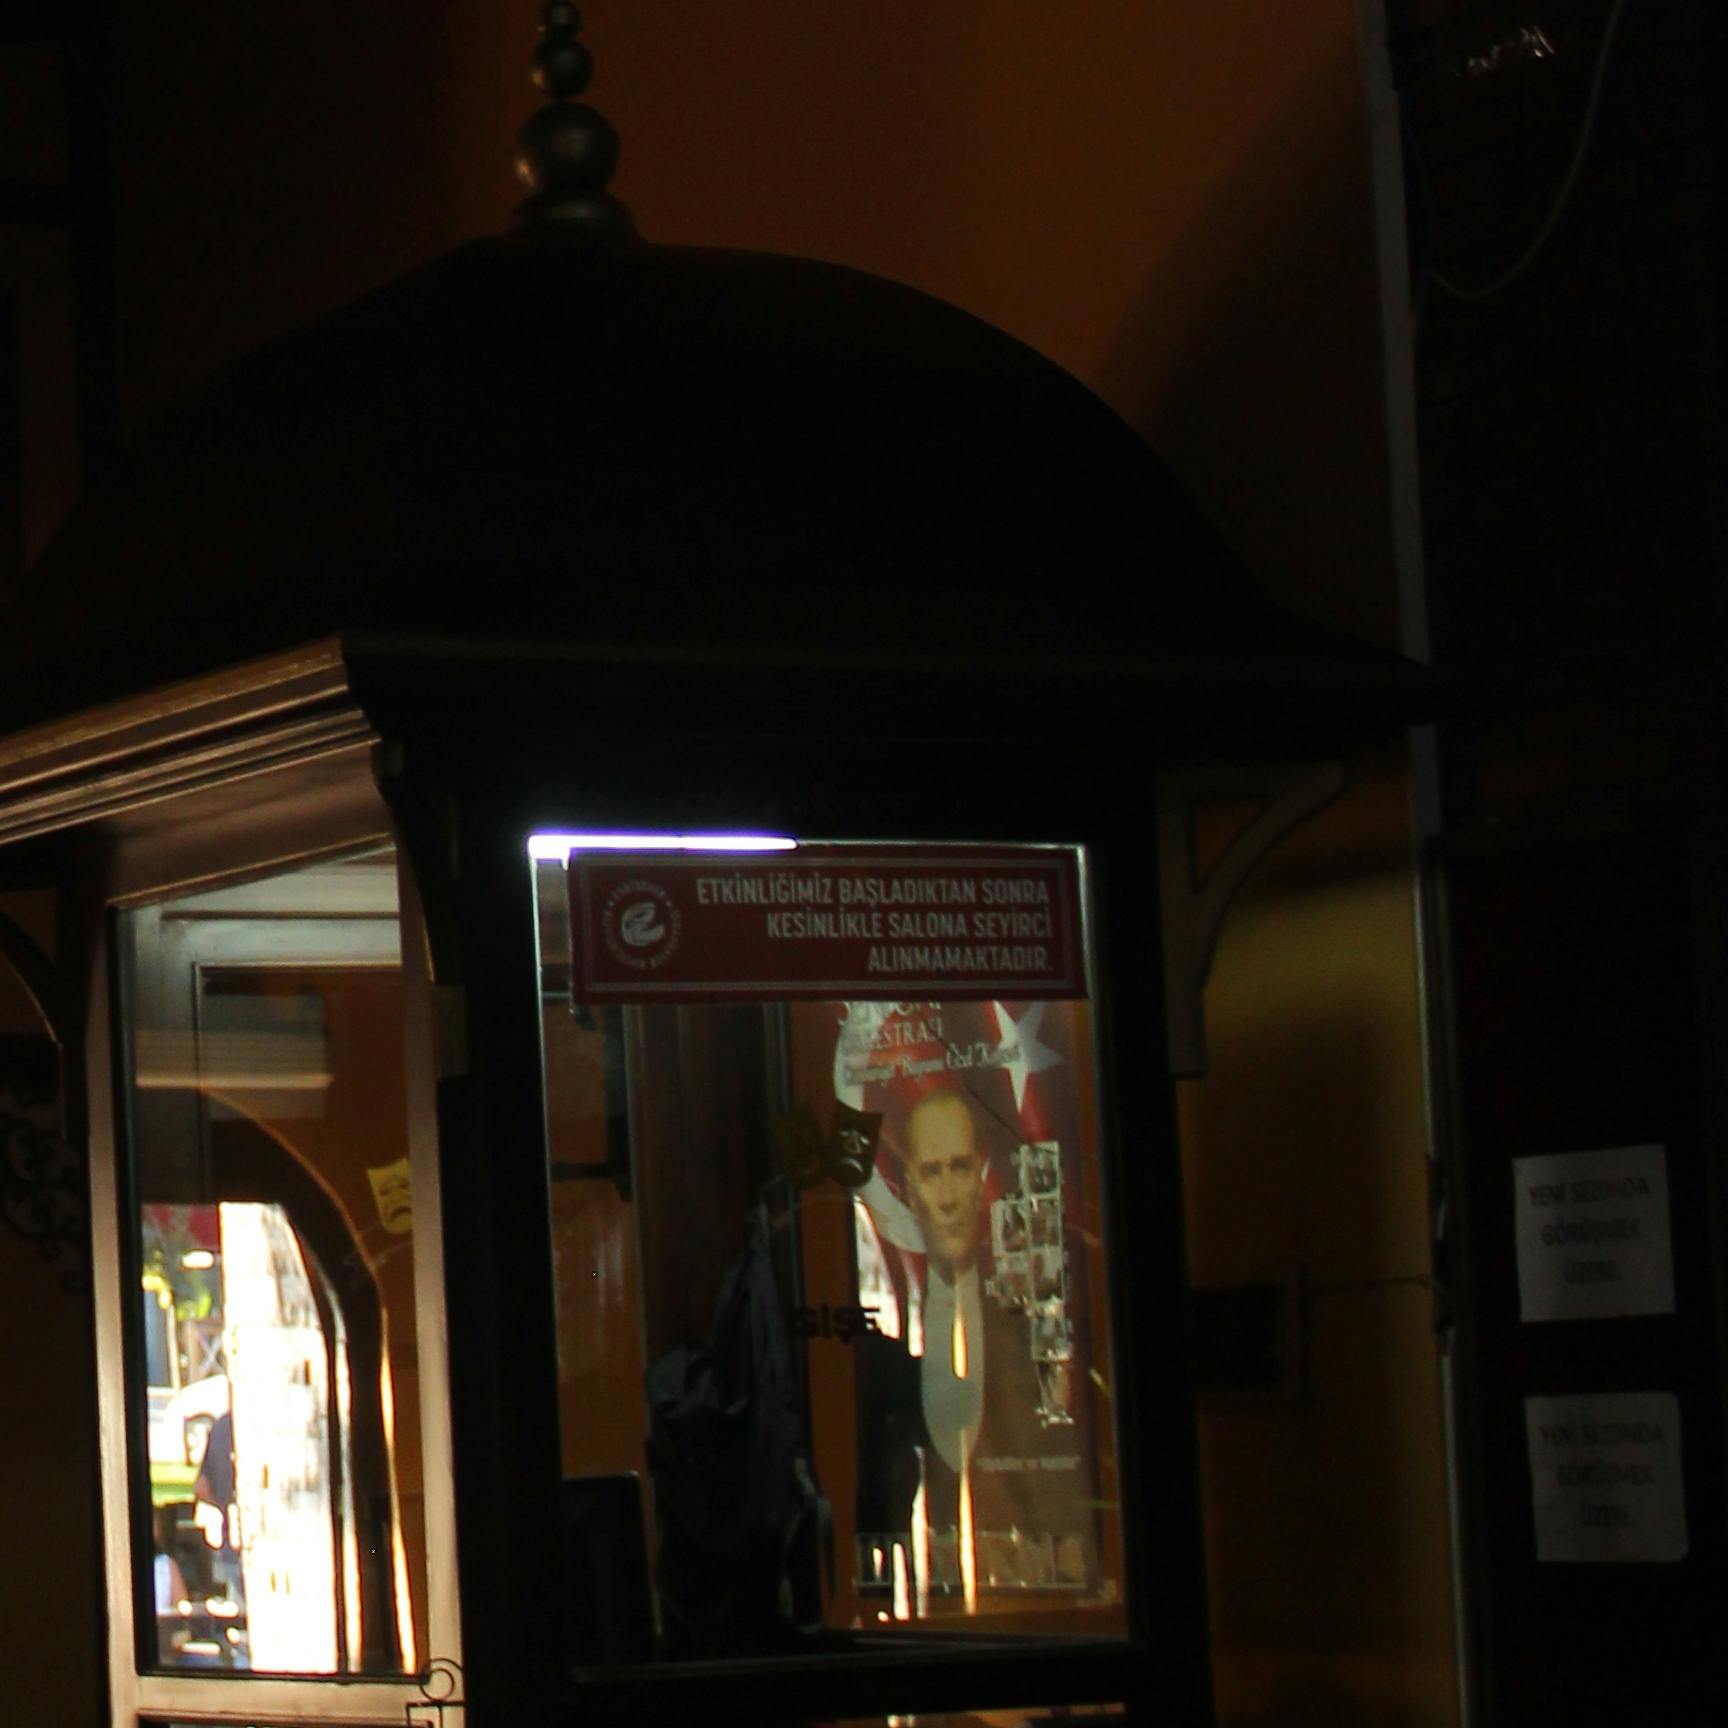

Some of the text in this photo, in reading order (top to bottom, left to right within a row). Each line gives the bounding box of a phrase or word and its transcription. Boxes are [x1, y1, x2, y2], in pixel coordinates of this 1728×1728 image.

[697, 873, 1050, 909] ETKİNLİĞİMİZ BAŞLADIKTAN SONRA
[767, 906, 1053, 939] KESİNLİKLE SALONA SEYİRCİ
[868, 945, 1052, 973] ALINMAMAKTADIR.
